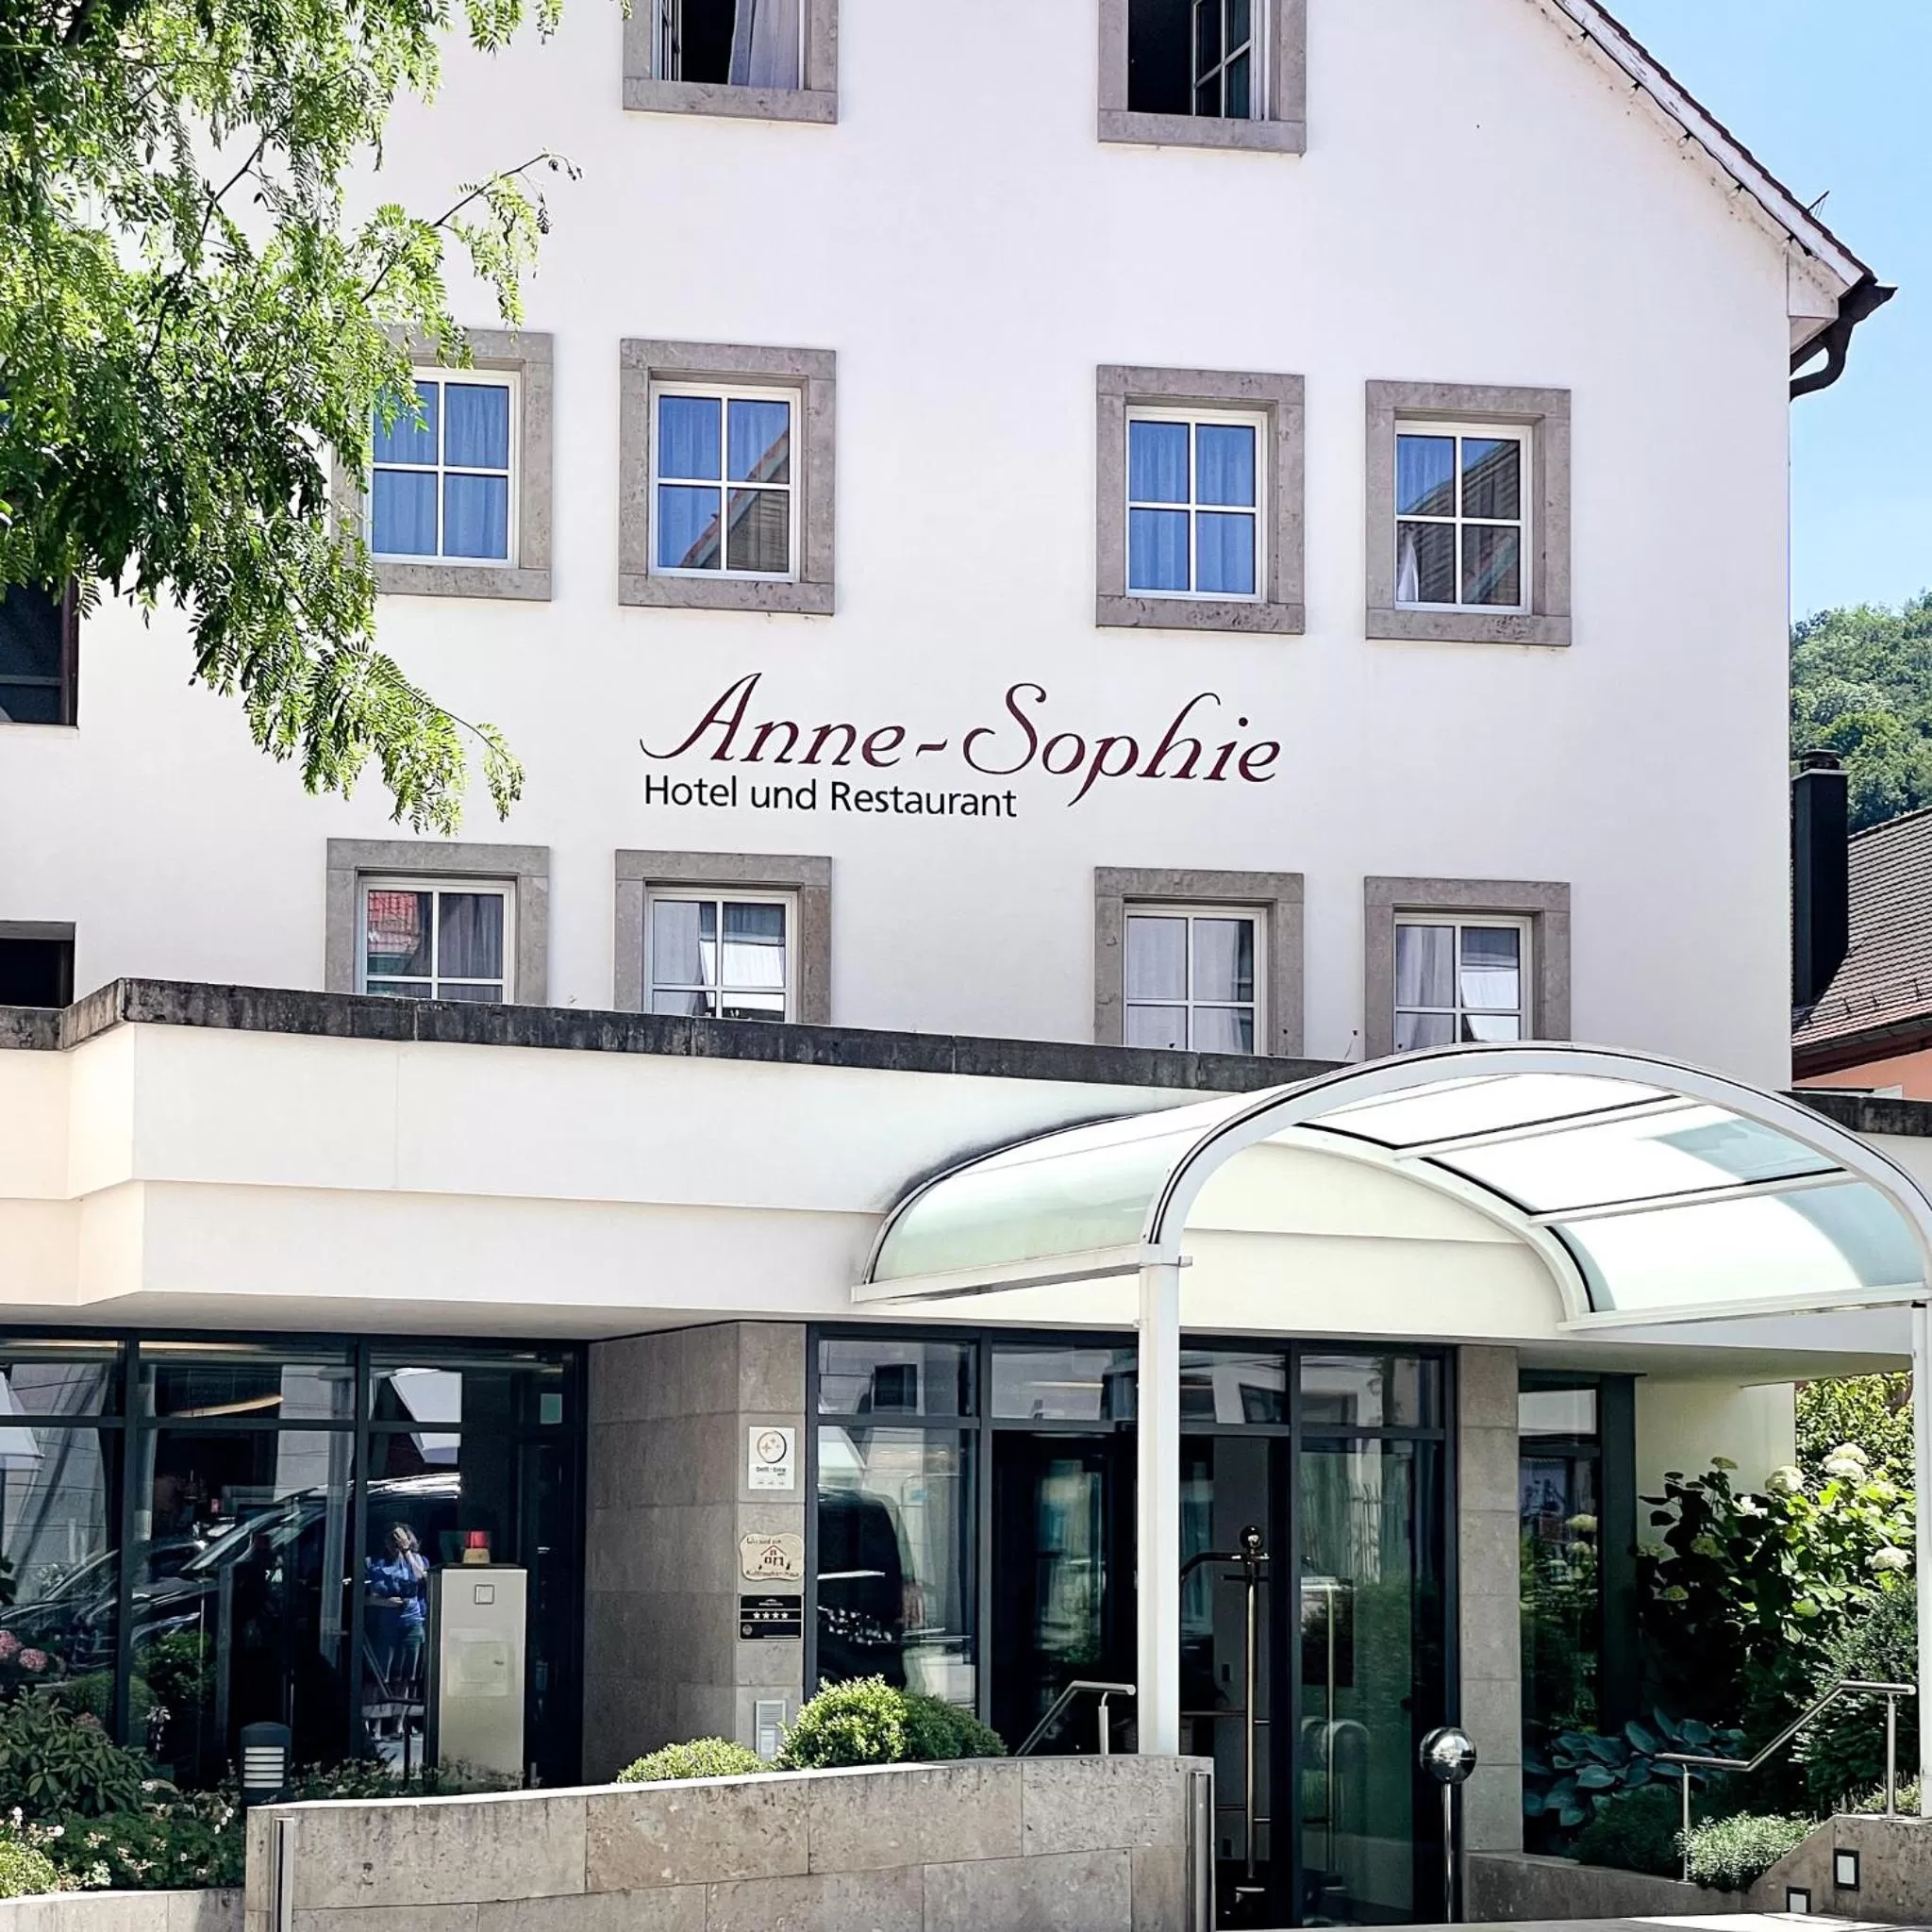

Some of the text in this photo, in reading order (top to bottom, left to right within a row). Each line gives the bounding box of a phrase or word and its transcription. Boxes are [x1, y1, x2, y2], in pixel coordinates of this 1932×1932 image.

[640, 673, 1281, 808] Anne-Sophie
[645, 774, 1018, 818] Hotel und Restaurant
